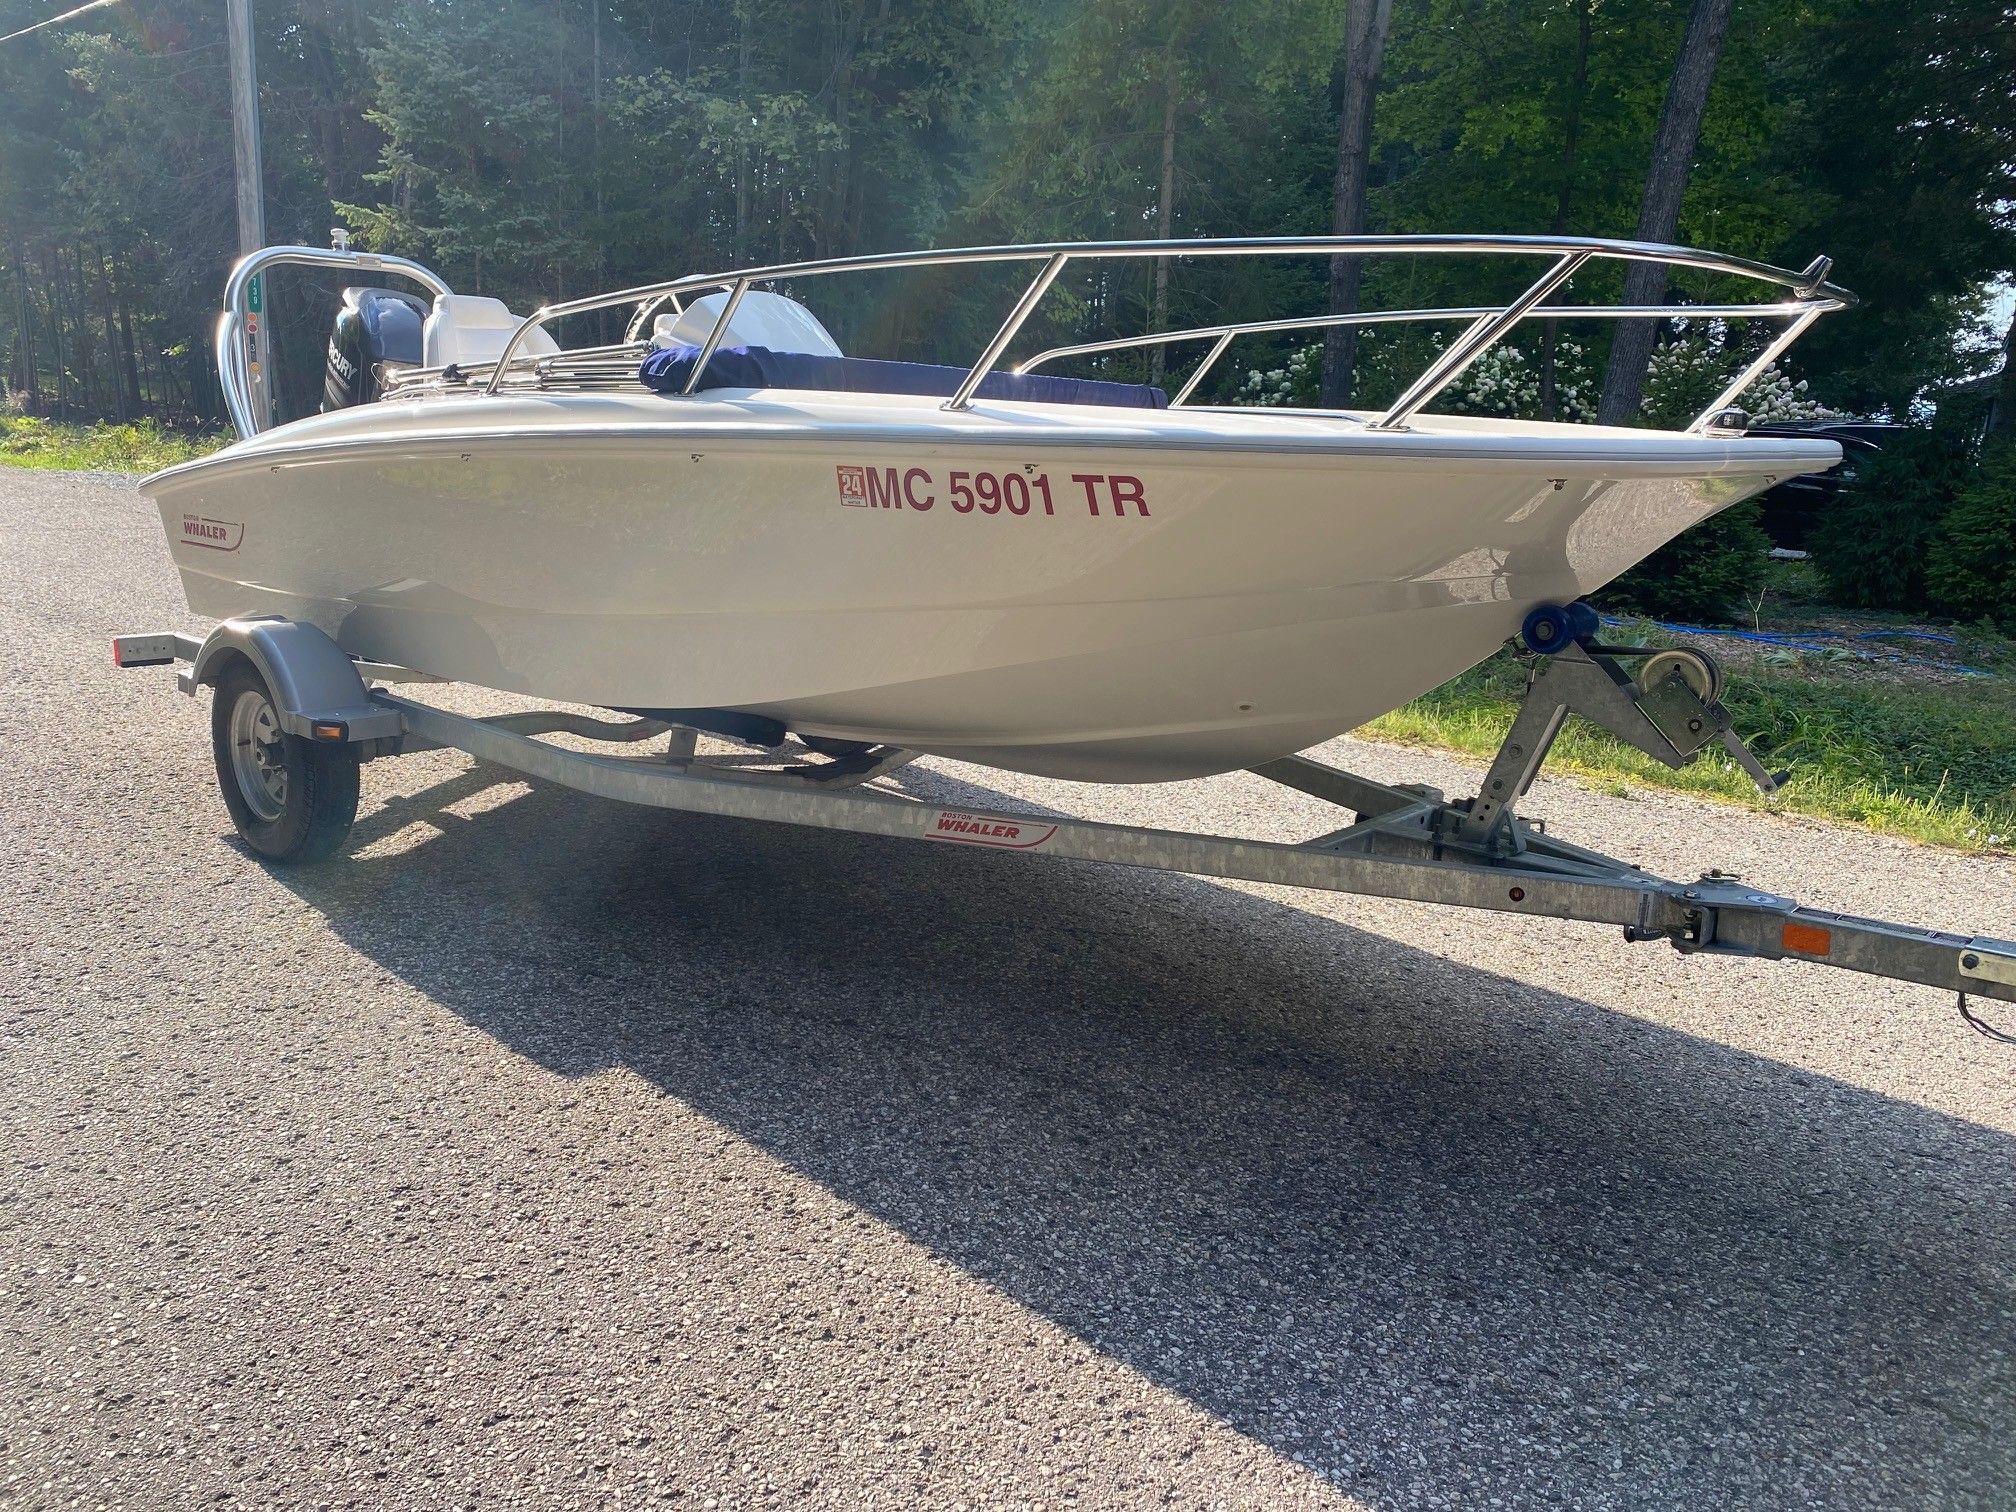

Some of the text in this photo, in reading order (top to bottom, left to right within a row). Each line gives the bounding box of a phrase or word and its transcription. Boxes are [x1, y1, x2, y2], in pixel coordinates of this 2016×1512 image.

[328, 336, 358, 380] RCURY
[841, 474, 862, 496] 24
[865, 466, 1152, 517] MC 5901 TR
[183, 521, 227, 541] WHALER
[941, 811, 973, 821] BOSTON
[937, 818, 1020, 839] WHALER
